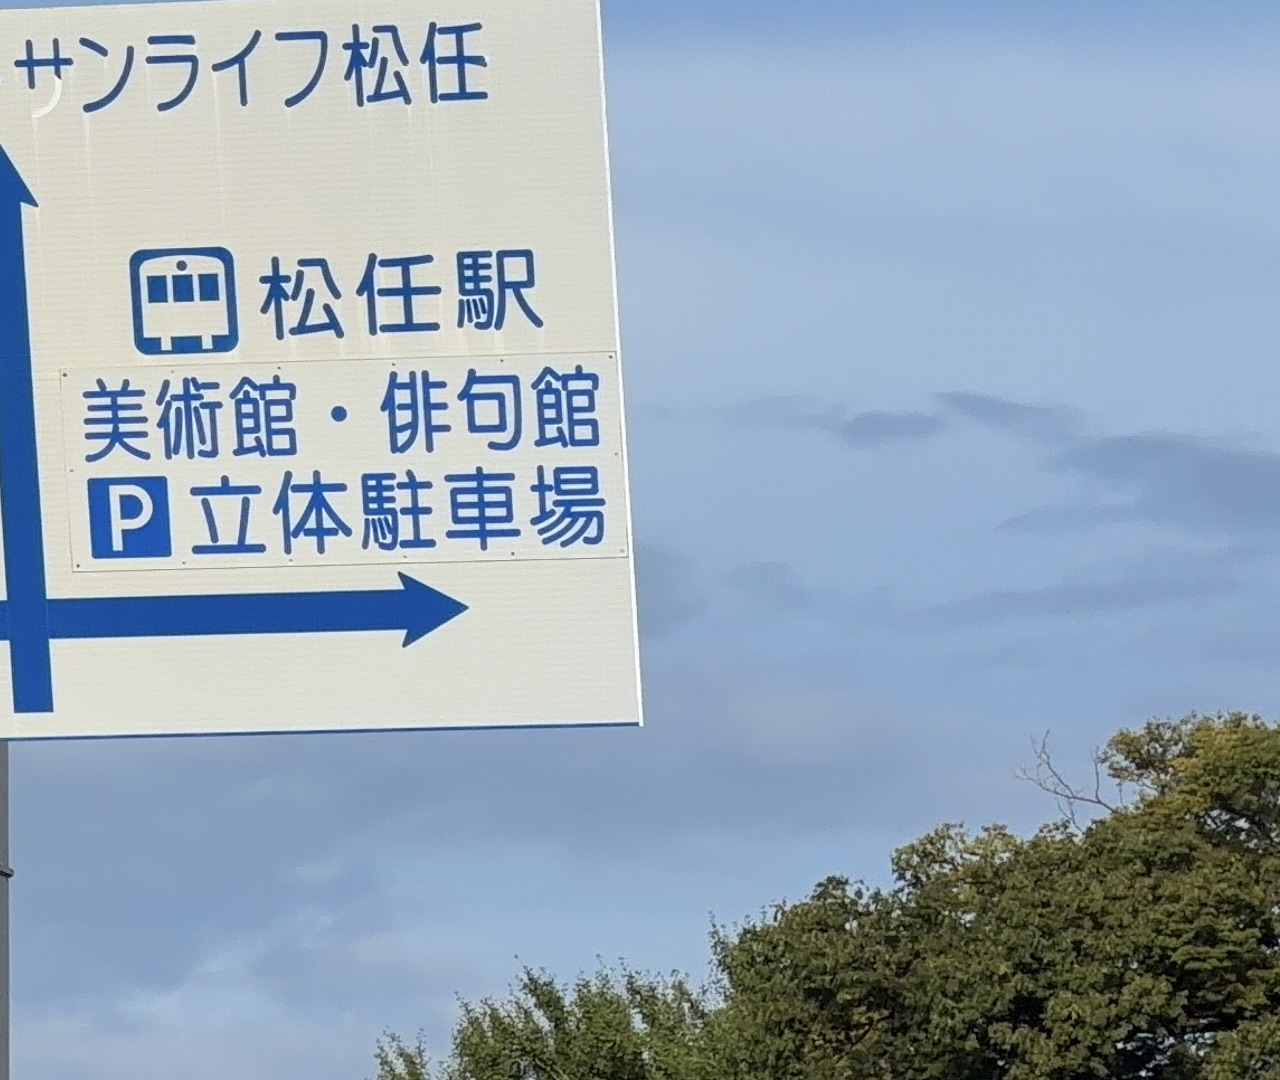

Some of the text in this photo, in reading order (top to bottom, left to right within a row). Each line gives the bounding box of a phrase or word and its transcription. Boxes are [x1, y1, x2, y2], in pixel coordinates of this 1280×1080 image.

[260, 248, 544, 338] 松任駅
[82, 365, 601, 463] 美術館・俳句館
[189, 465, 607, 555] 立体駐車場
